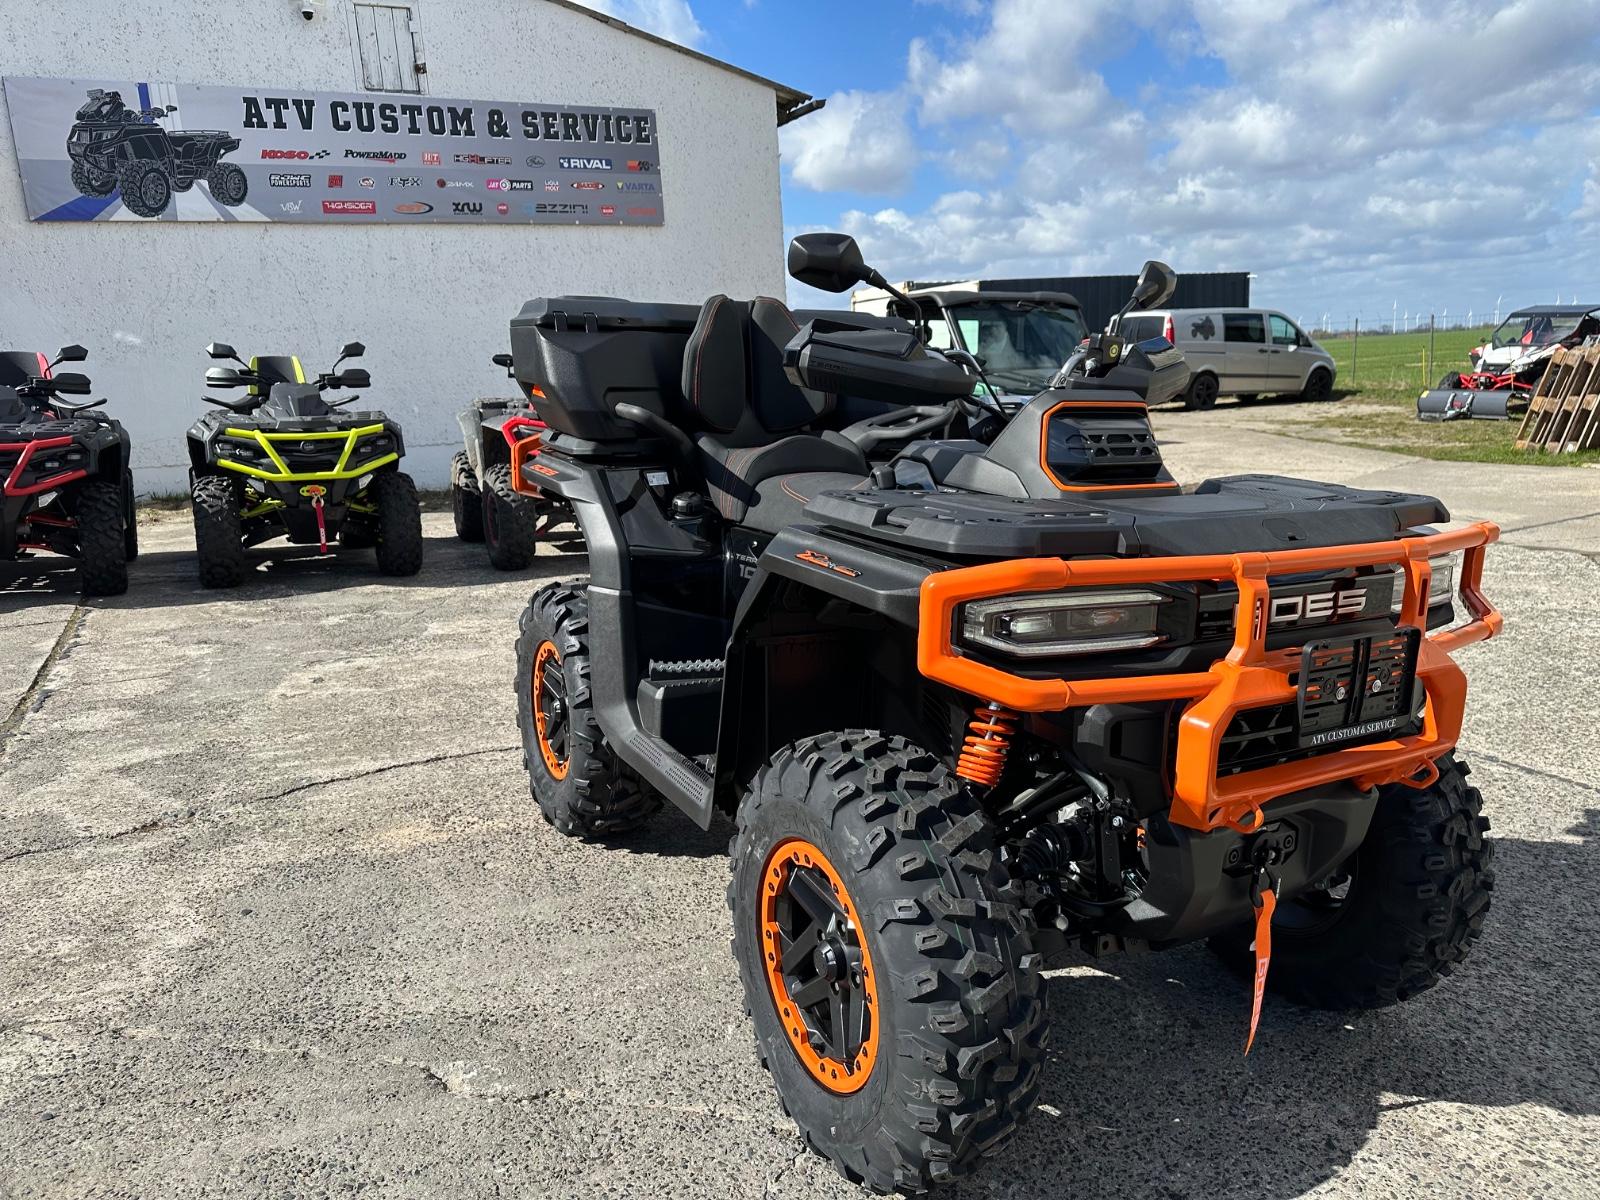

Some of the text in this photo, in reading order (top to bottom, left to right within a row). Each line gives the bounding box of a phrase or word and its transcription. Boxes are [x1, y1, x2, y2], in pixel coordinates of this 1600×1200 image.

[242, 97, 652, 145] ATV CUSTOM & SERVICE
[570, 158, 611, 170] RIVAL
[512, 181, 532, 190] PARTS
[625, 182, 655, 192] VARTA
[1310, 732, 1326, 746] ATV
[1327, 726, 1360, 742] CUSTOM
[1366, 718, 1398, 734] SERVICE
